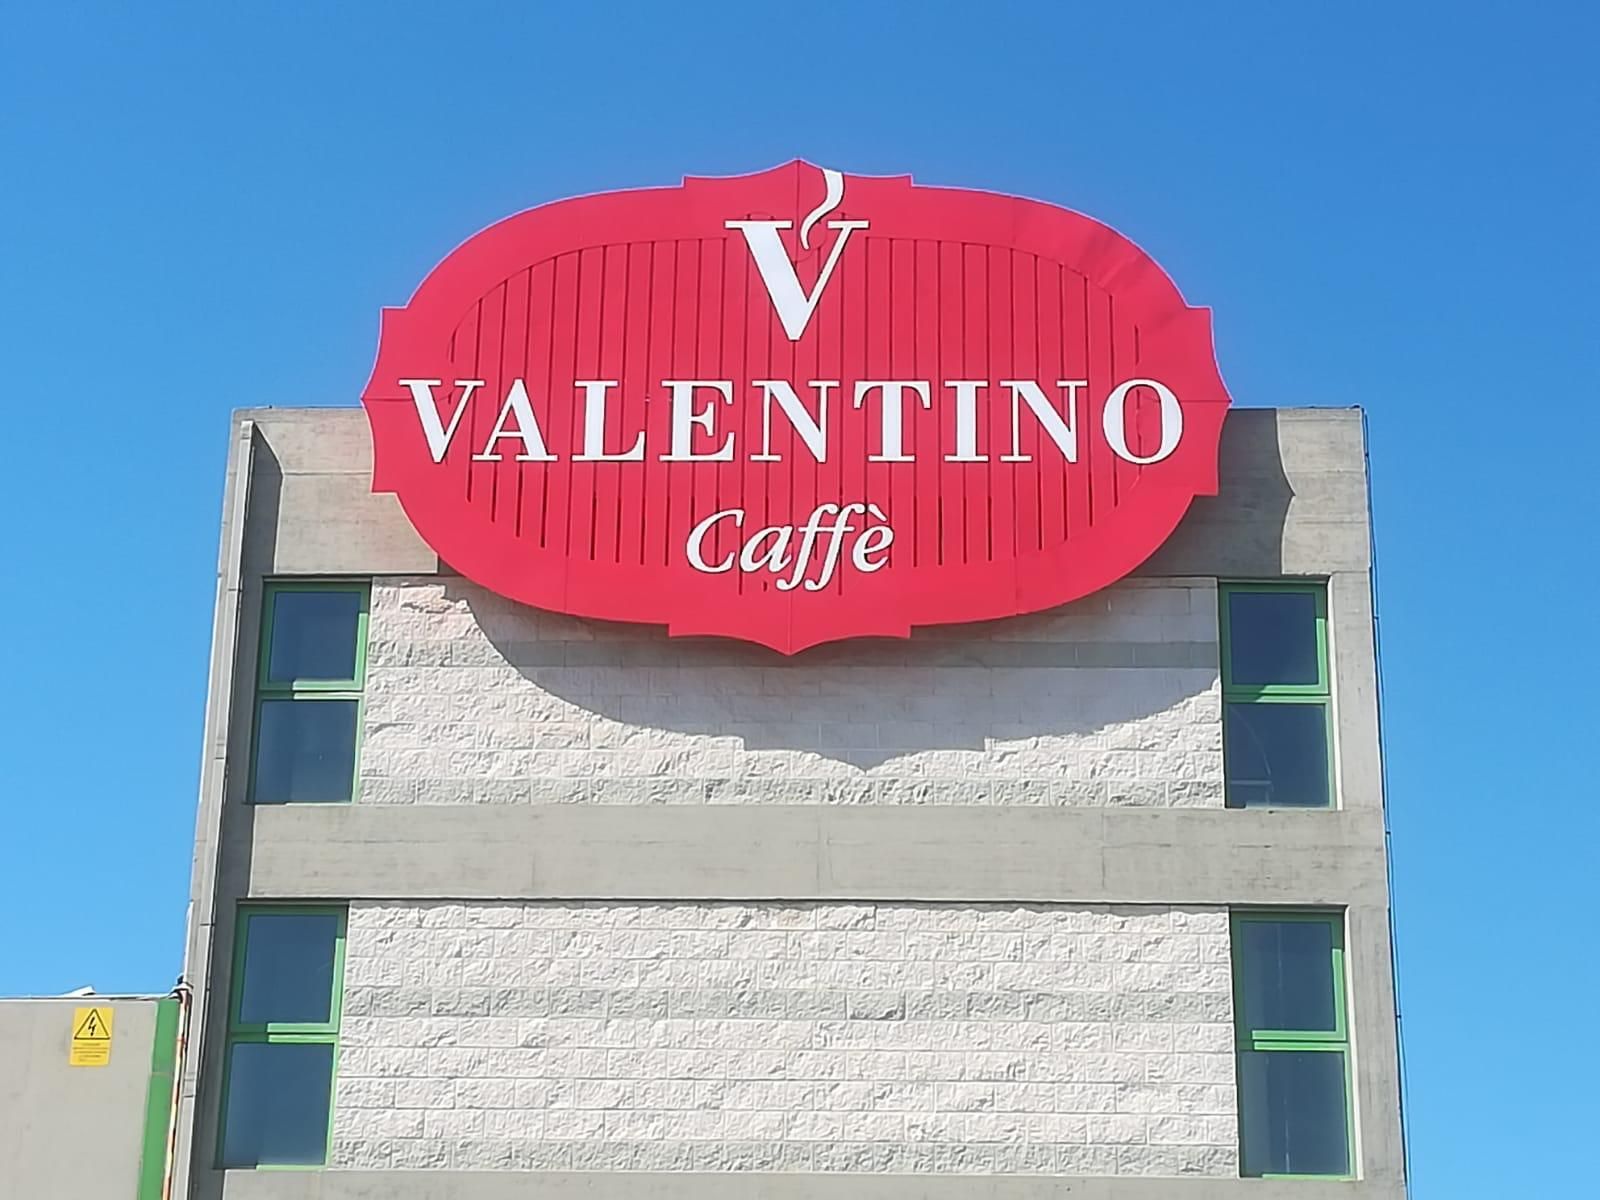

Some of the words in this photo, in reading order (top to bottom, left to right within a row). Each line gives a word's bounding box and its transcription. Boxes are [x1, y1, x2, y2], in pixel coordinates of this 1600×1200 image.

[725, 219, 869, 341] V
[398, 378, 1184, 465] VALENTINO
[686, 503, 894, 592] Caffè
